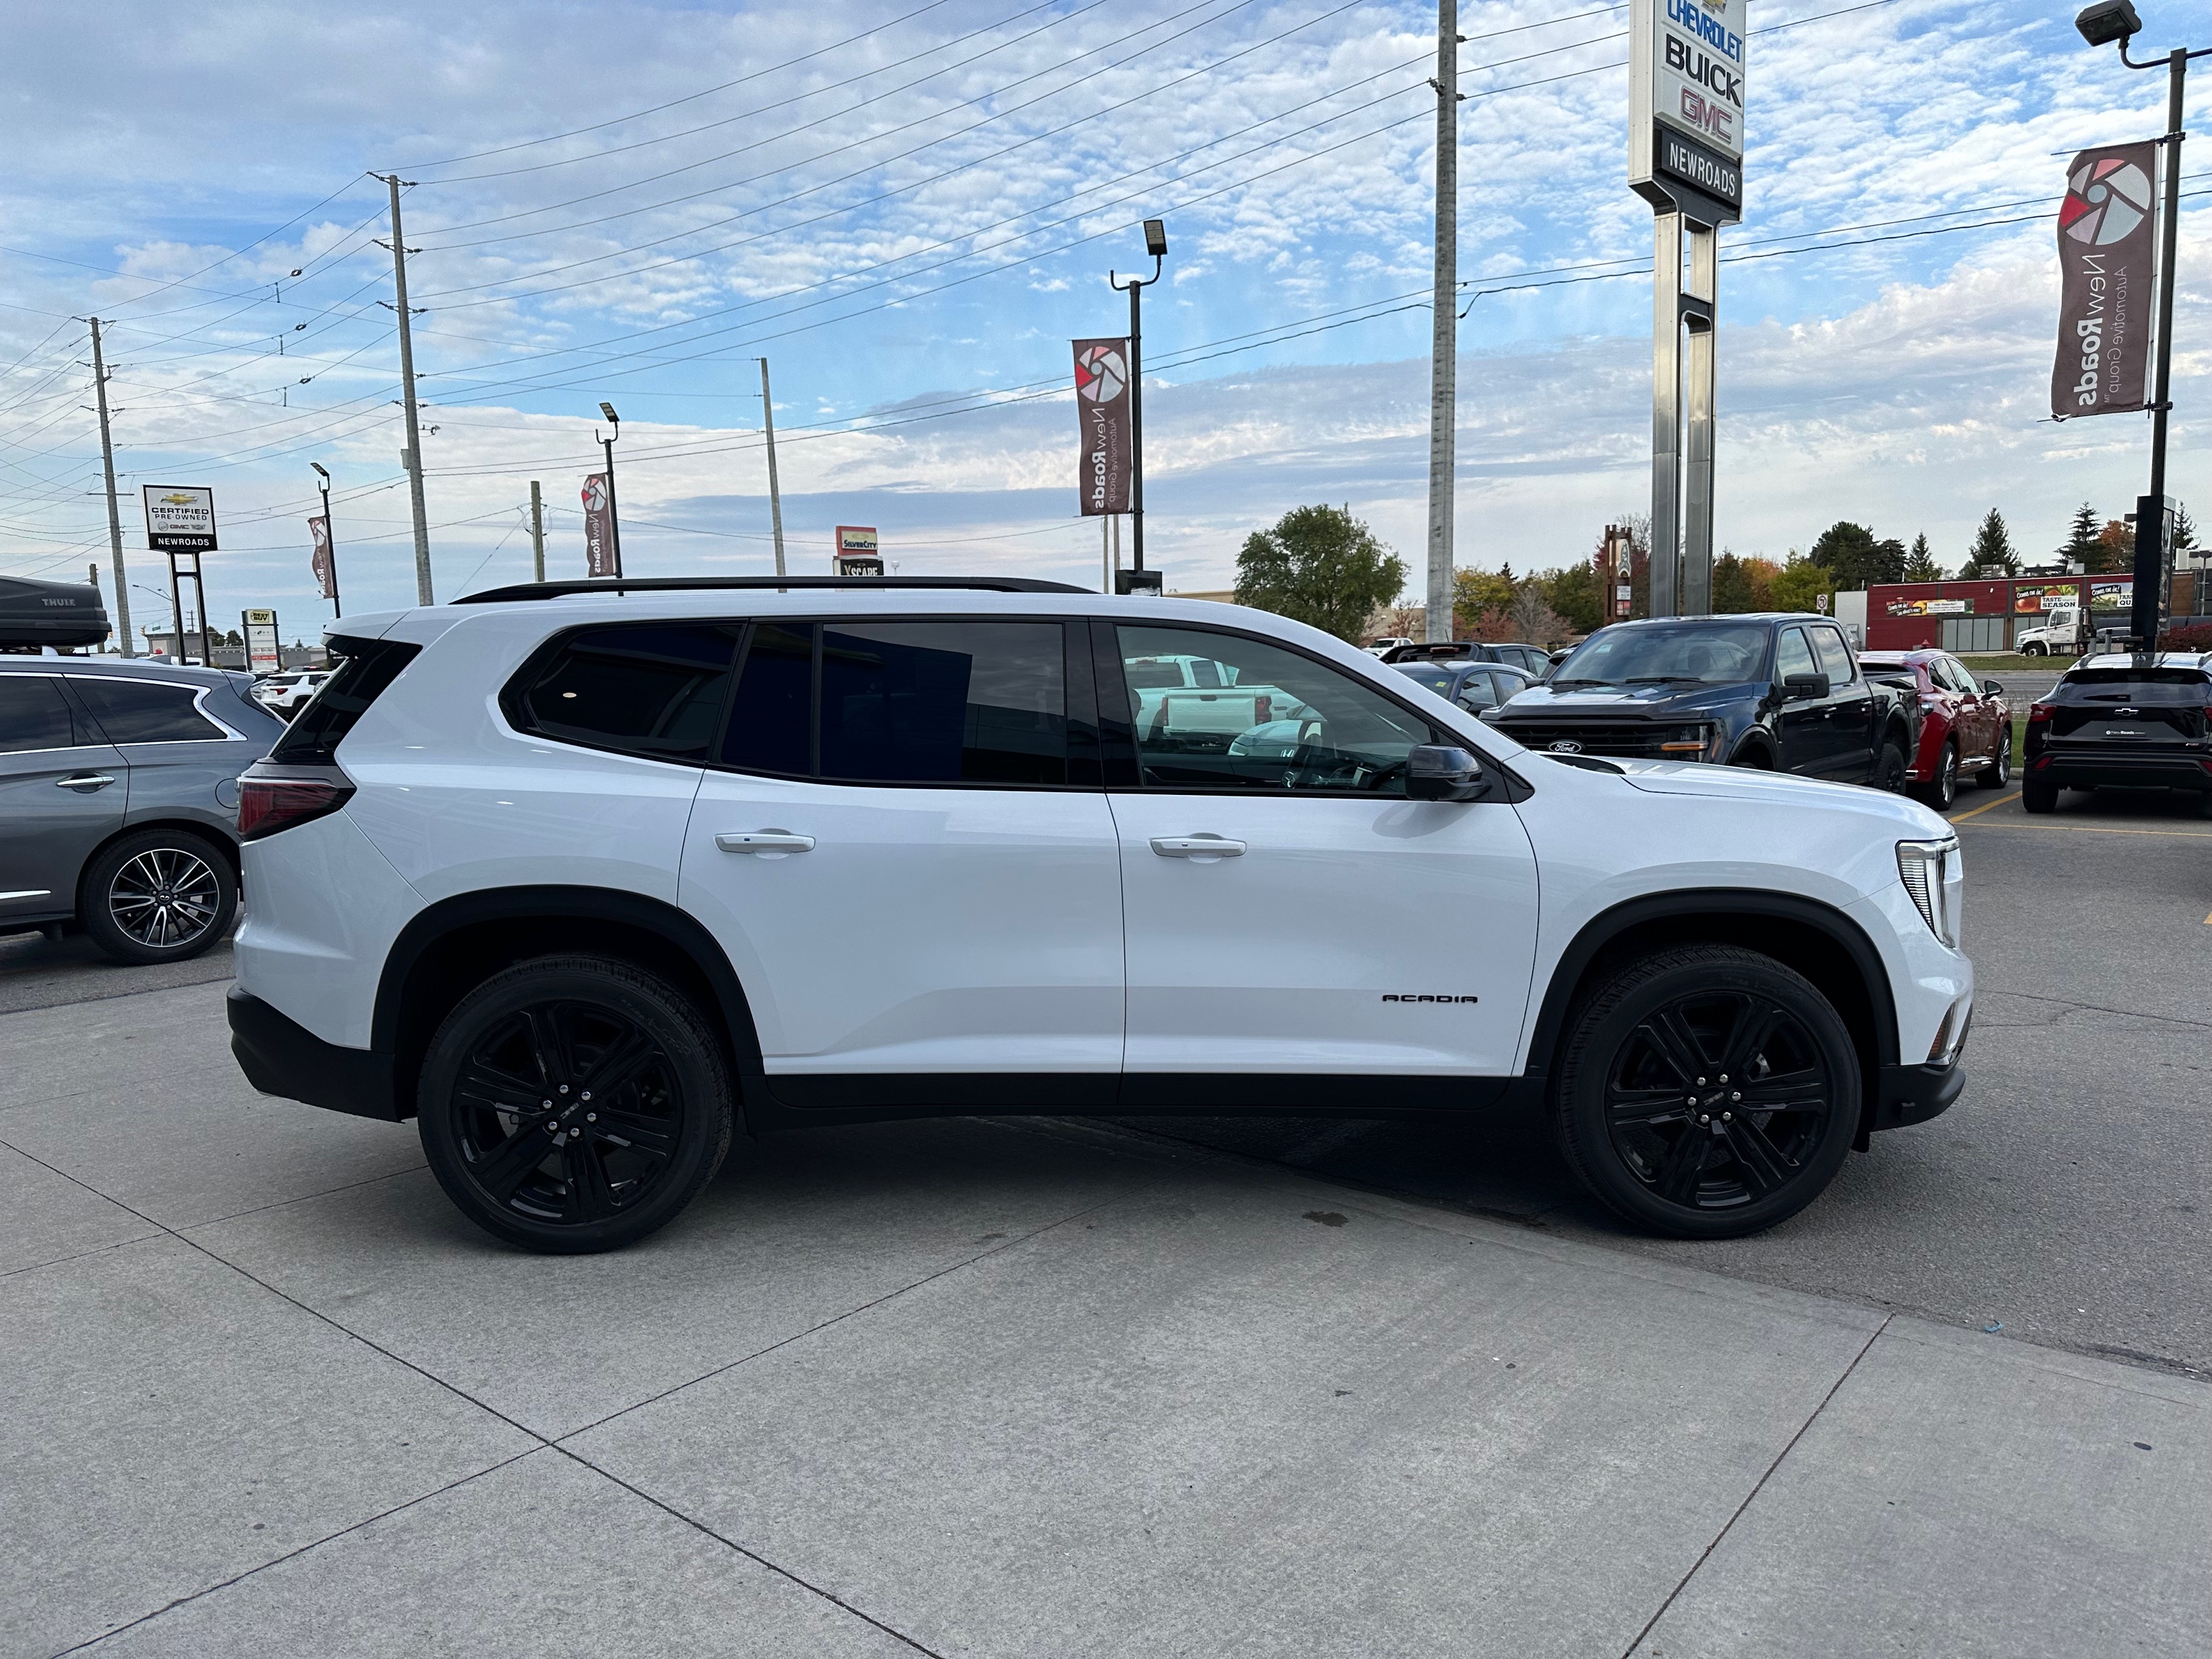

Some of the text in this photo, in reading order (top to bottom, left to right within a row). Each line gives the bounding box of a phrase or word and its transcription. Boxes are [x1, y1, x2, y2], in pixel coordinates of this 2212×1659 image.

[1668, 0, 1743, 63] CHEVROLET
[1665, 33, 1742, 108] BUICK
[1681, 85, 1732, 145] GMC
[1669, 142, 1735, 197] NEWROADS
[42, 598, 76, 607] THULE
[1555, 743, 1575, 753] Ford
[1382, 994, 1478, 1004] ACADIA
